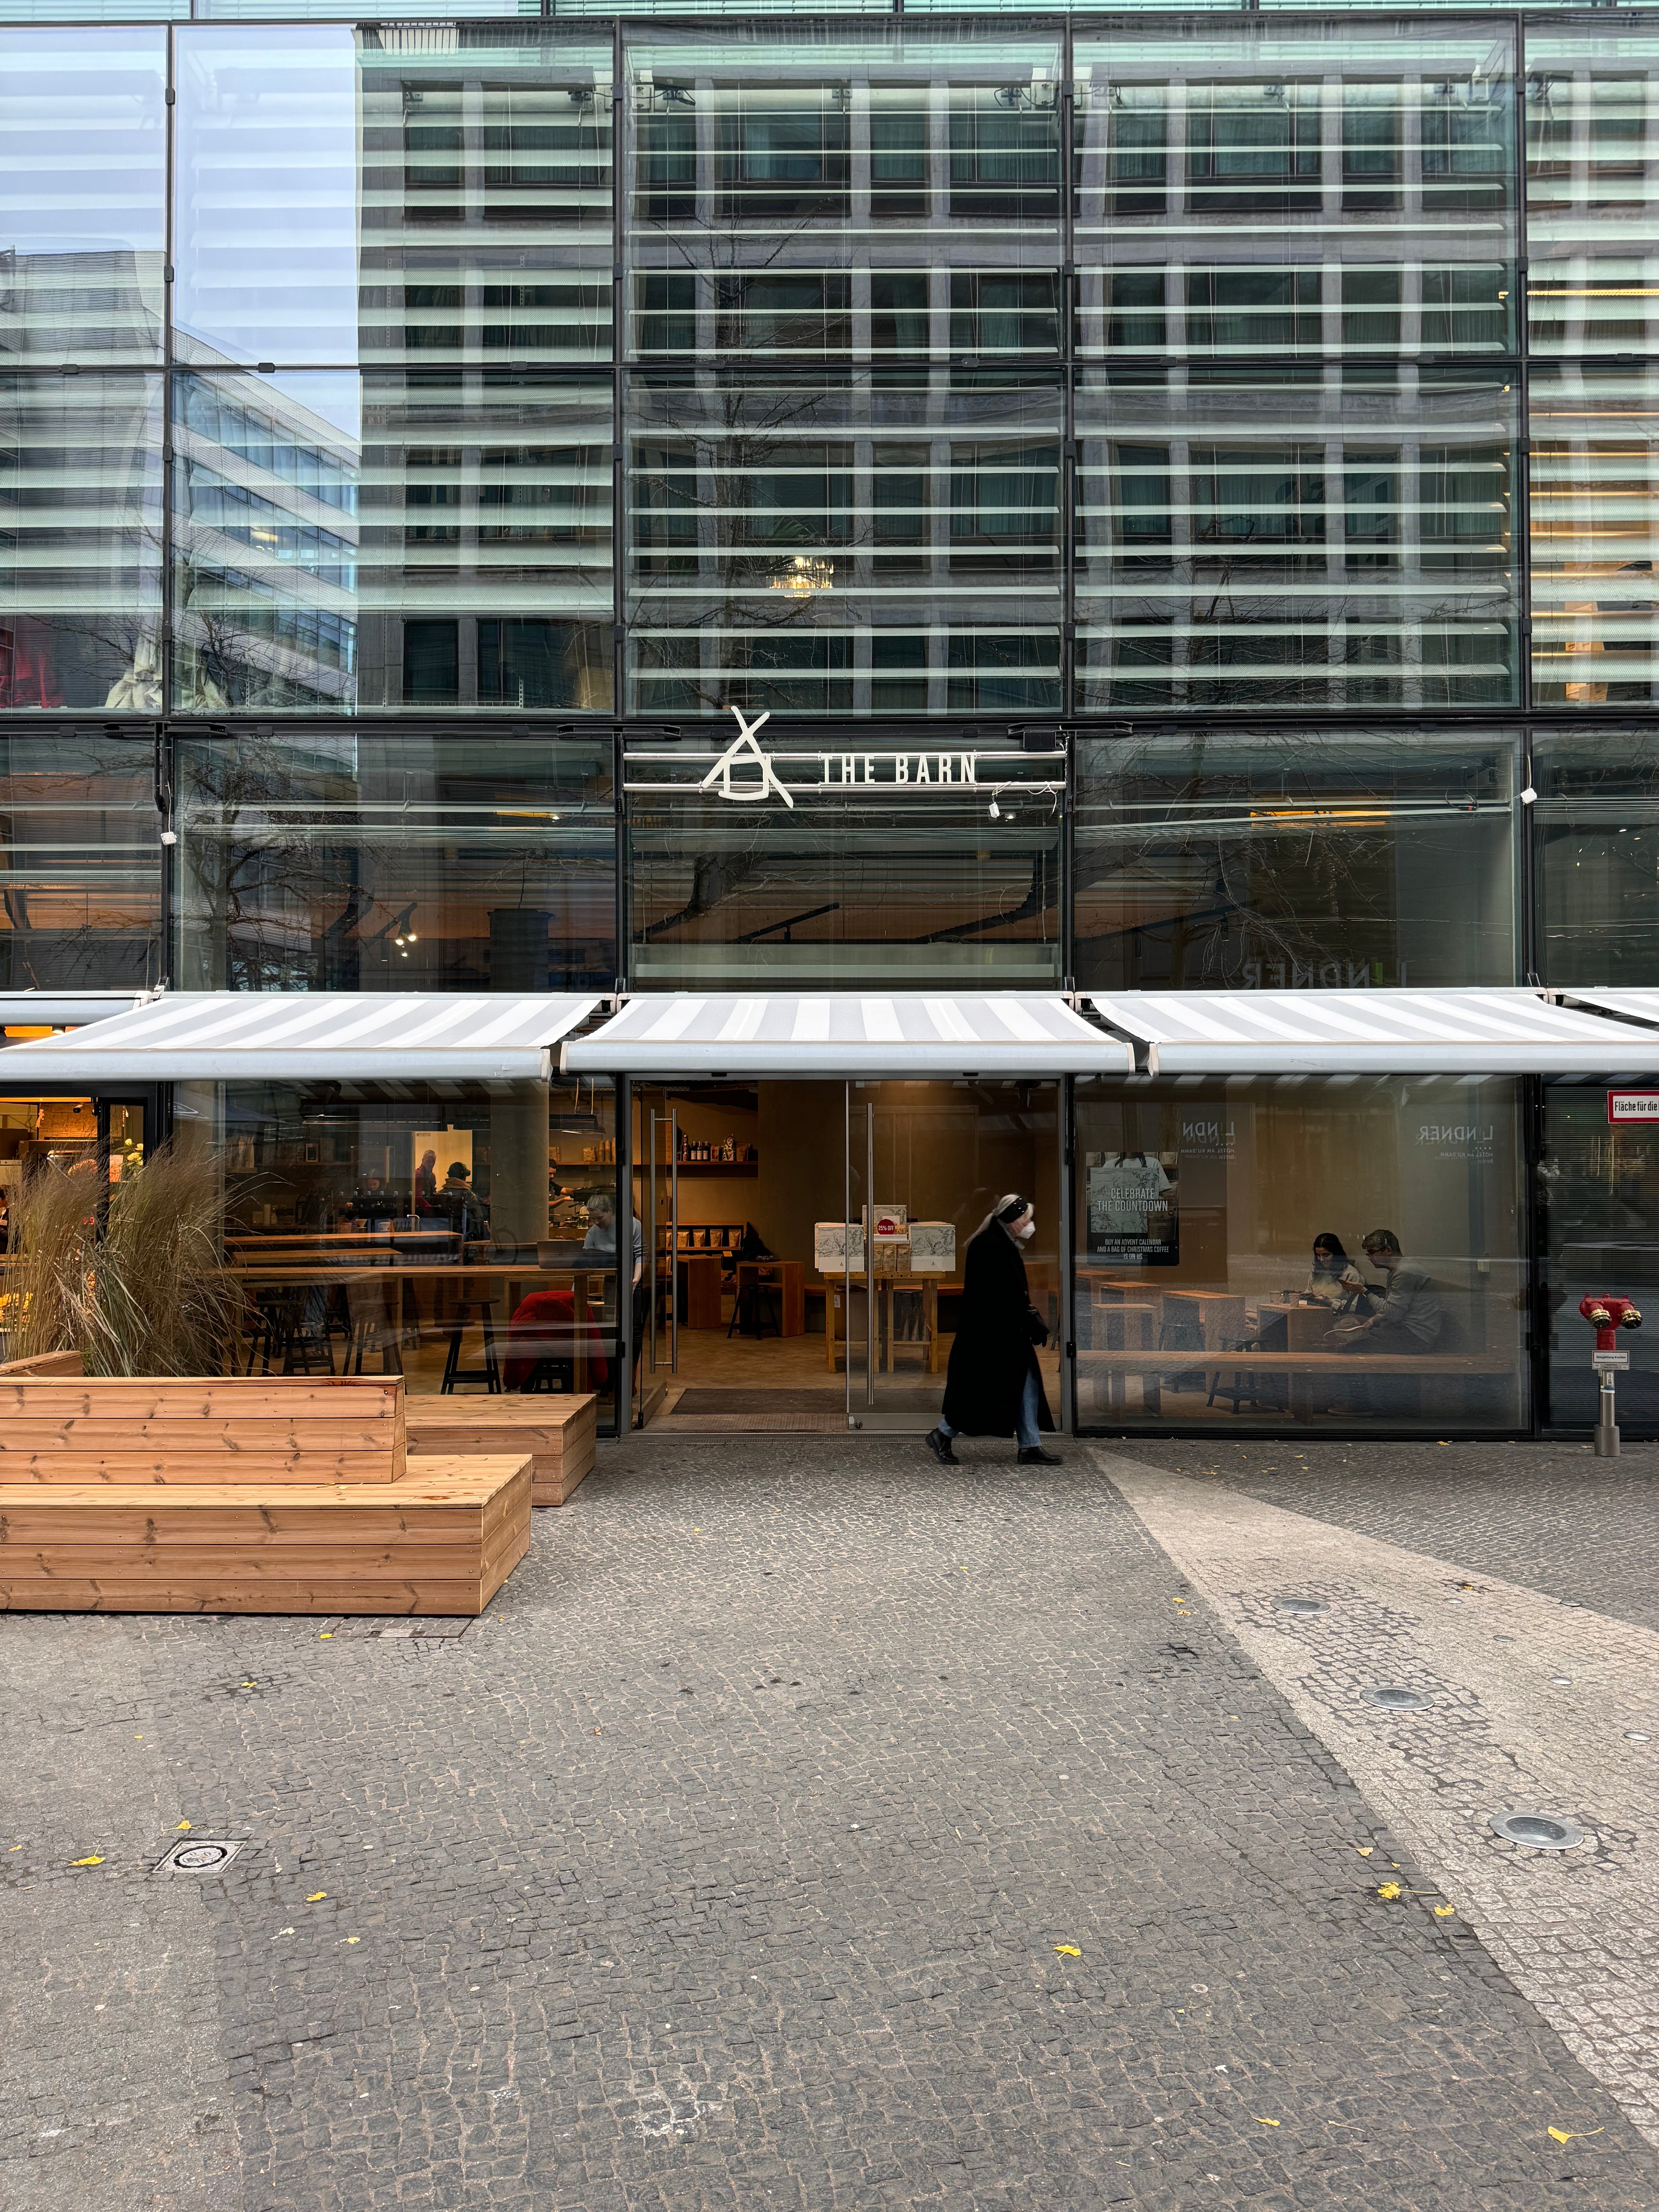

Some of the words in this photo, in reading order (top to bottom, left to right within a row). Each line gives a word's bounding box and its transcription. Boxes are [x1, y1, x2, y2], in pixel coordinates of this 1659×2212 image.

[821, 755, 875, 785] THE
[896, 754, 975, 784] BARN
[1615, 1101, 1636, 1111] Fläche
[1637, 1101, 1647, 1111] für
[1648, 1101, 1657, 1111] die
[1111, 1188, 1154, 1199] CELEBRATE
[1097, 1200, 1112, 1212] THE
[1115, 1200, 1168, 1212] COUNTDOWN
